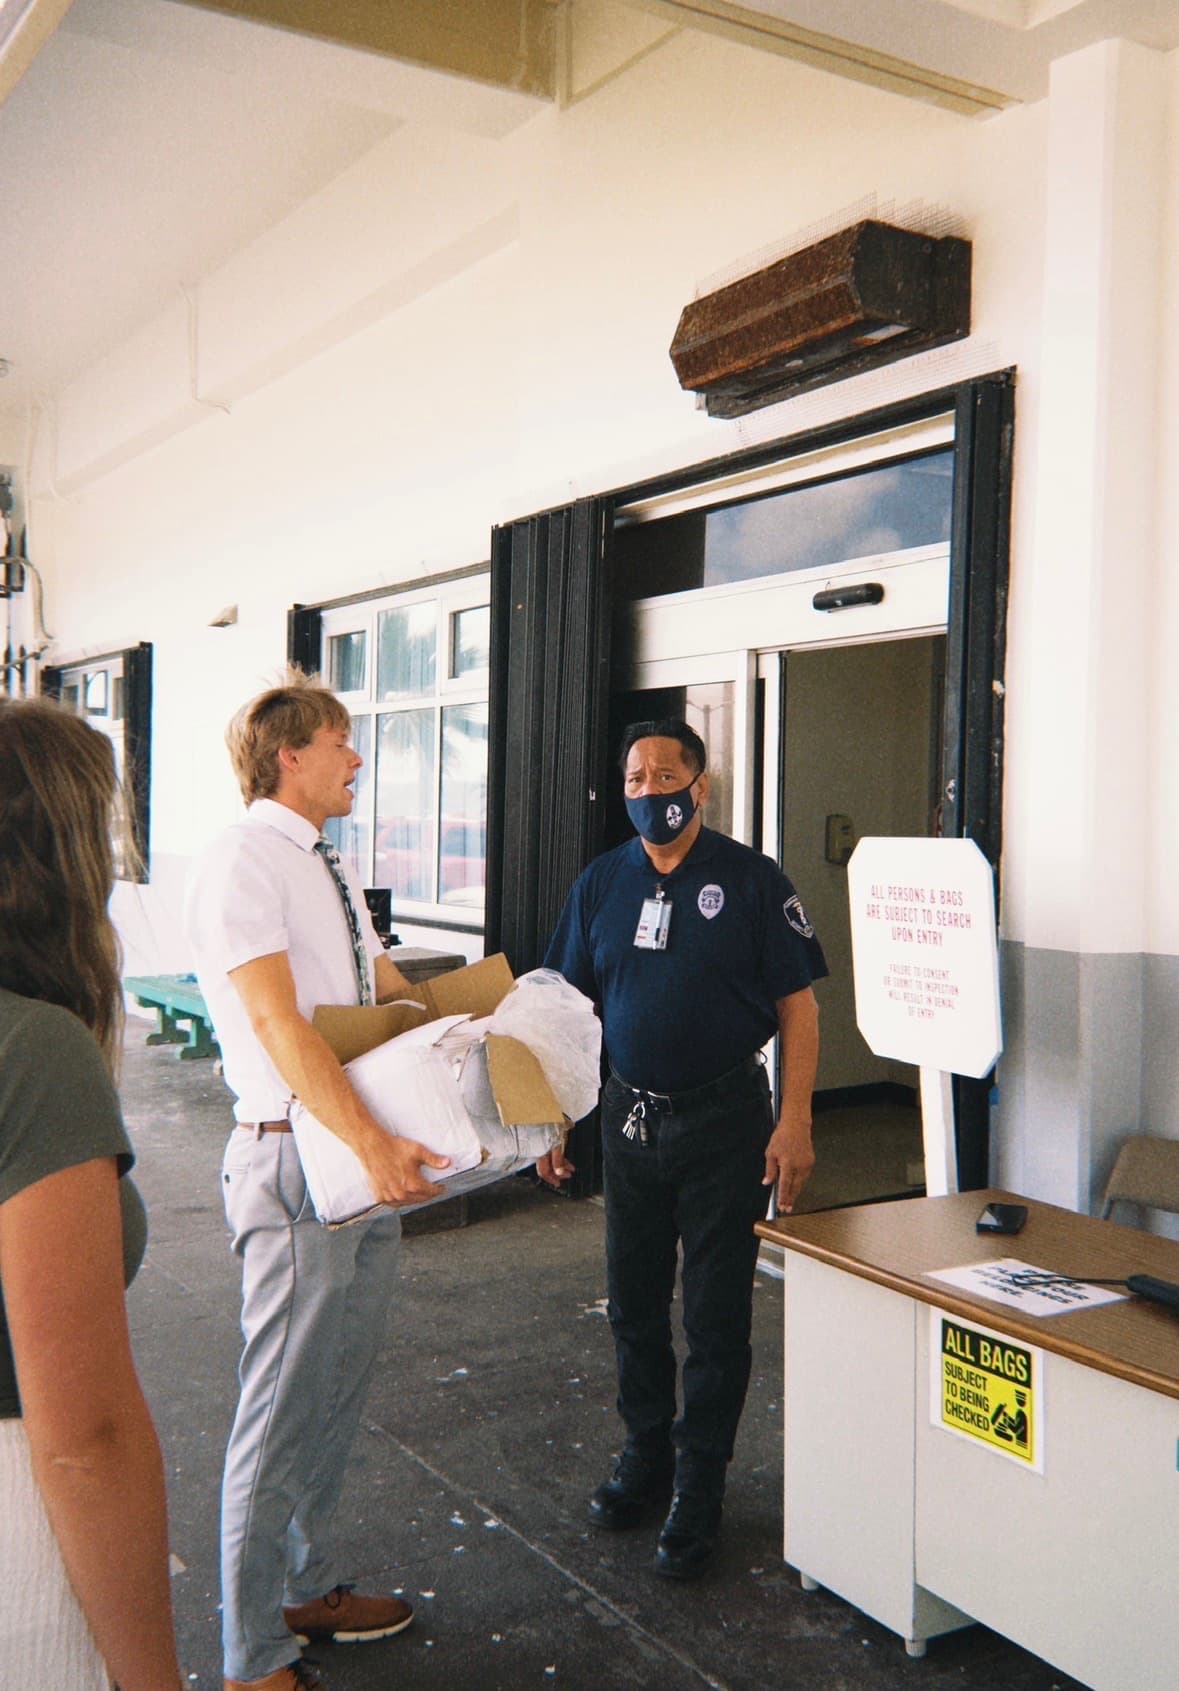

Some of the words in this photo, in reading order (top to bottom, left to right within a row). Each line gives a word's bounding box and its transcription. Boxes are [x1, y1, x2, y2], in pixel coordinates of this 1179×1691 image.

[871, 885, 884, 899] ALL
[888, 886, 926, 903] PERSONS
[930, 889, 936, 904] &
[940, 890, 963, 906] BAGS
[866, 903, 881, 919] ARE
[885, 905, 918, 923] SUBJECT
[922, 908, 933, 925] TO
[936, 910, 971, 928] SEARCH
[892, 926, 913, 942] UPON
[917, 929, 943, 946] ENTRY
[923, 967, 950, 980] CONSENT
[946, 1327, 976, 1362] ALL
[980, 1339, 1028, 1382] BAGS
[945, 1361, 988, 1391] SUBJECT
[945, 1379, 958, 1398] TO
[960, 1386, 990, 1412] BEING
[945, 1398, 990, 1431] CHECKED
